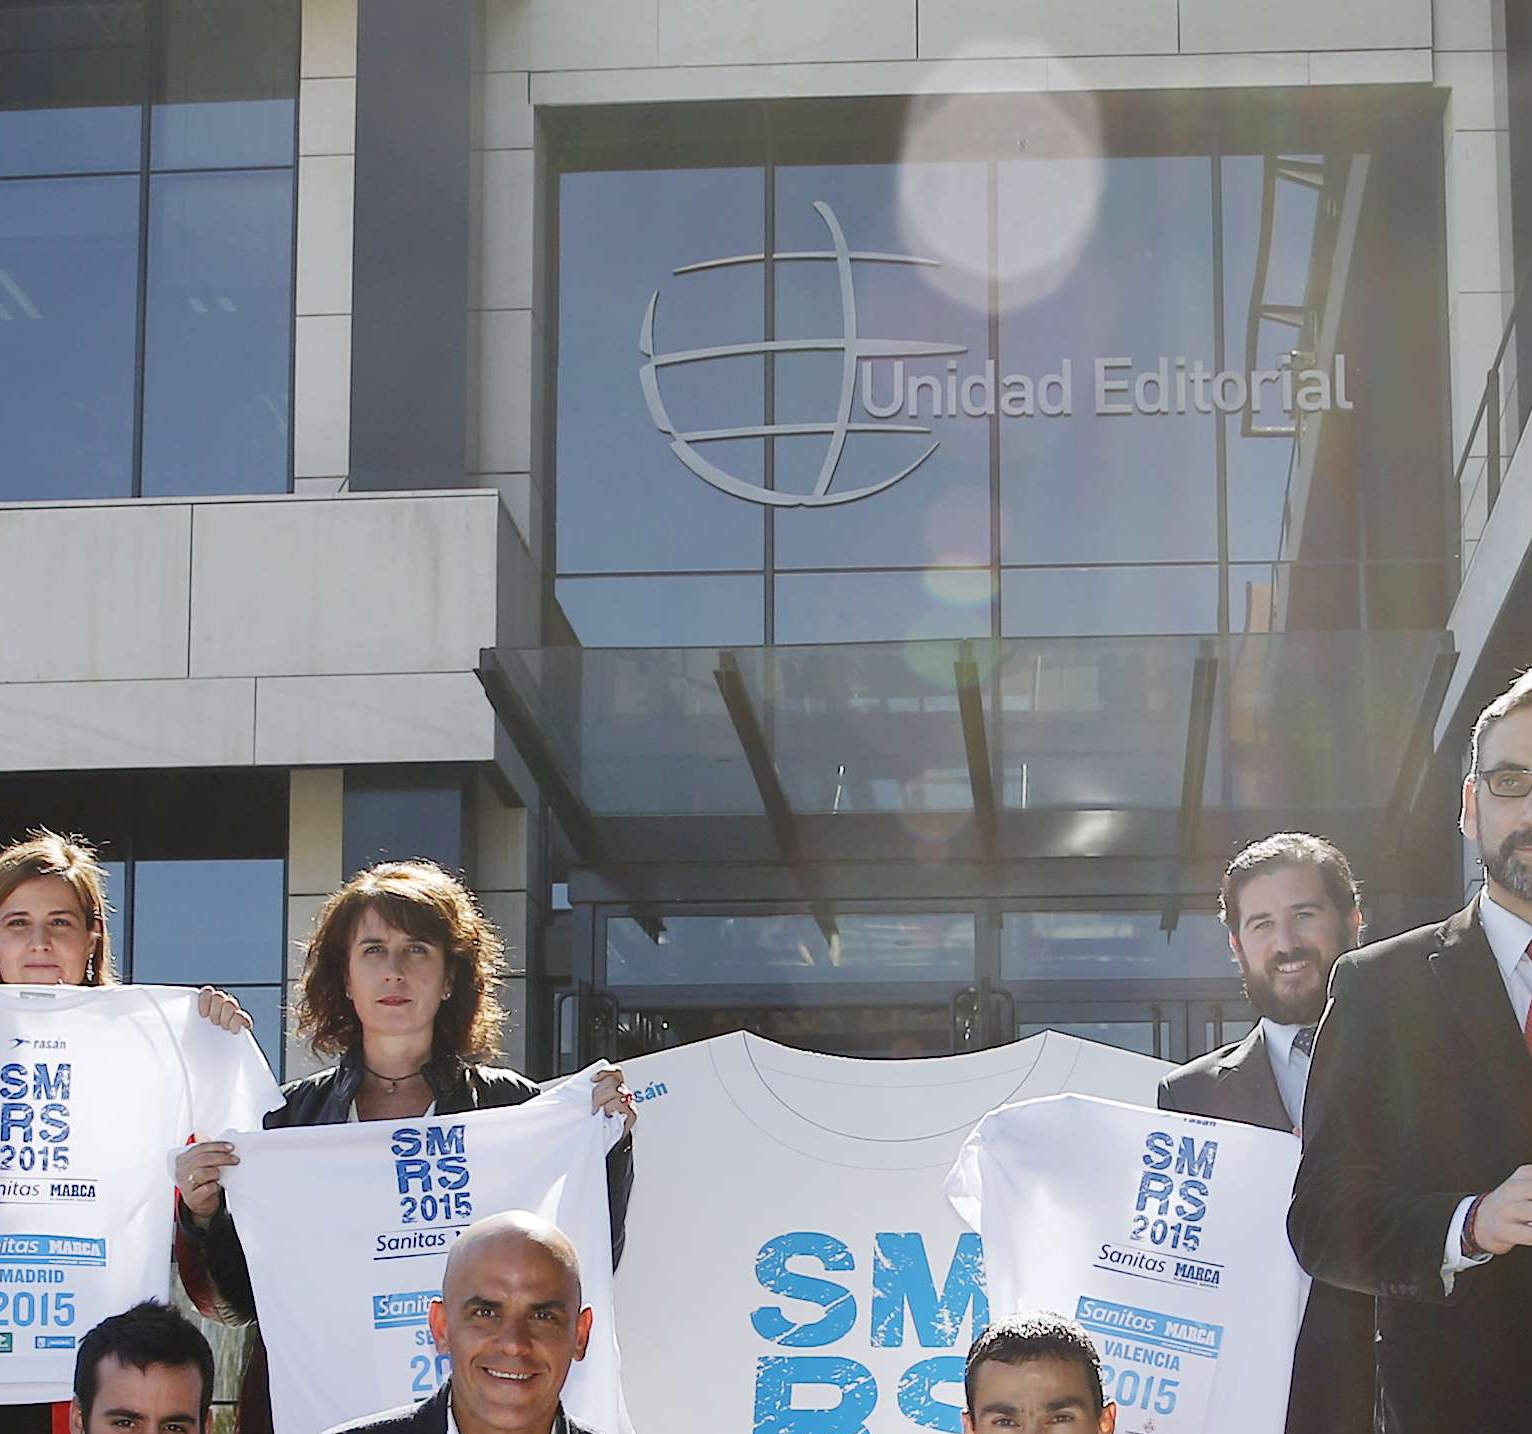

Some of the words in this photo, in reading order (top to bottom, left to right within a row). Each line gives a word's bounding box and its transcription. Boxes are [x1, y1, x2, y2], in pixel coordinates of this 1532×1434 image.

[861, 357, 1072, 419] Unidad
[1094, 353, 1355, 417] Editorial
[0, 1063, 71, 1100] SM
[633, 1080, 668, 1103] sán
[0, 1103, 71, 1143] RS
[391, 1124, 467, 1157] SM
[0, 1144, 70, 1172] 2015
[1142, 1131, 1219, 1180] SM
[49, 1183, 96, 1198] MARCA
[395, 1156, 470, 1194] RS
[399, 1191, 473, 1224] 2015
[1135, 1171, 1209, 1222] RS
[47, 1239, 102, 1257] MARCA
[376, 1231, 446, 1252] Sanitas
[1129, 1214, 1202, 1252] 2015
[1098, 1243, 1167, 1273] Sanitas
[1173, 1262, 1221, 1285] MARCA
[377, 1295, 431, 1317] Sanit
[749, 1231, 991, 1348] SM
[1079, 1300, 1157, 1333] Sanitas
[1163, 1320, 1217, 1346] MARCA
[1103, 1339, 1181, 1372] VALENCIA
